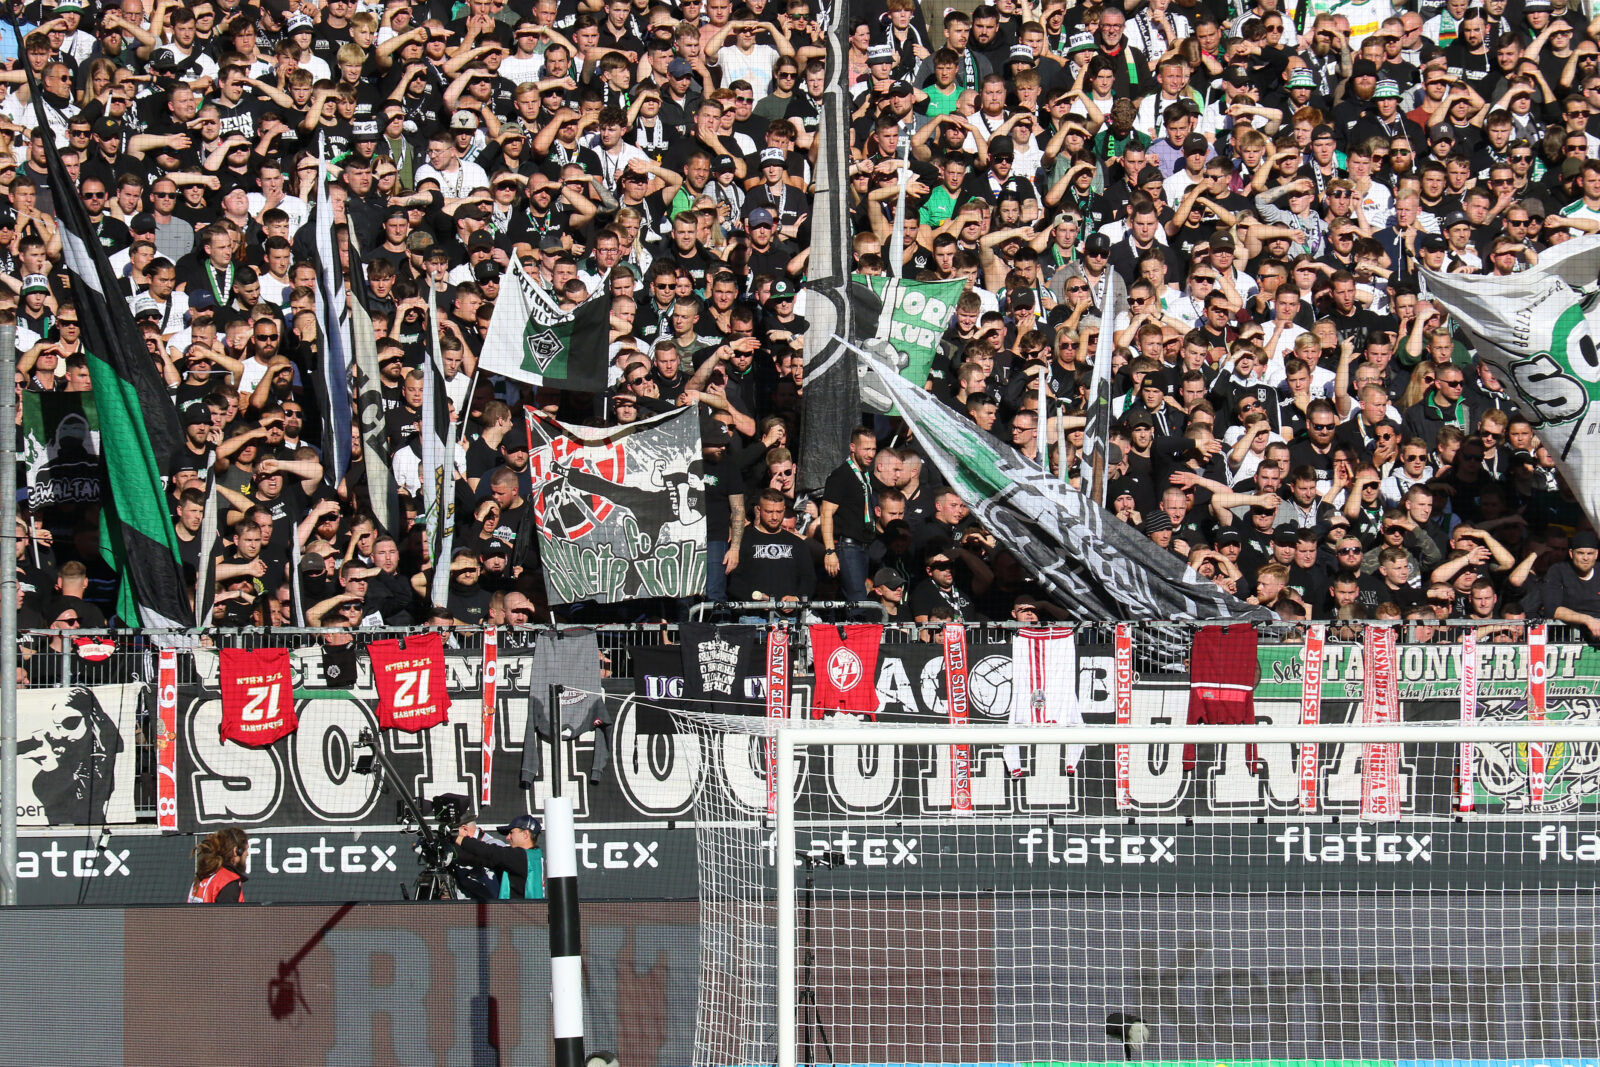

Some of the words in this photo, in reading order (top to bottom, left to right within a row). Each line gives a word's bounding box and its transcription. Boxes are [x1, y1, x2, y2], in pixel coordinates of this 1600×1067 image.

[771, 645, 785, 687] FANS
[950, 643, 965, 672] WIR
[241, 683, 281, 721] 12
[393, 668, 430, 708] 12
[952, 674, 967, 714] SIND
[1531, 825, 1600, 861] fla
